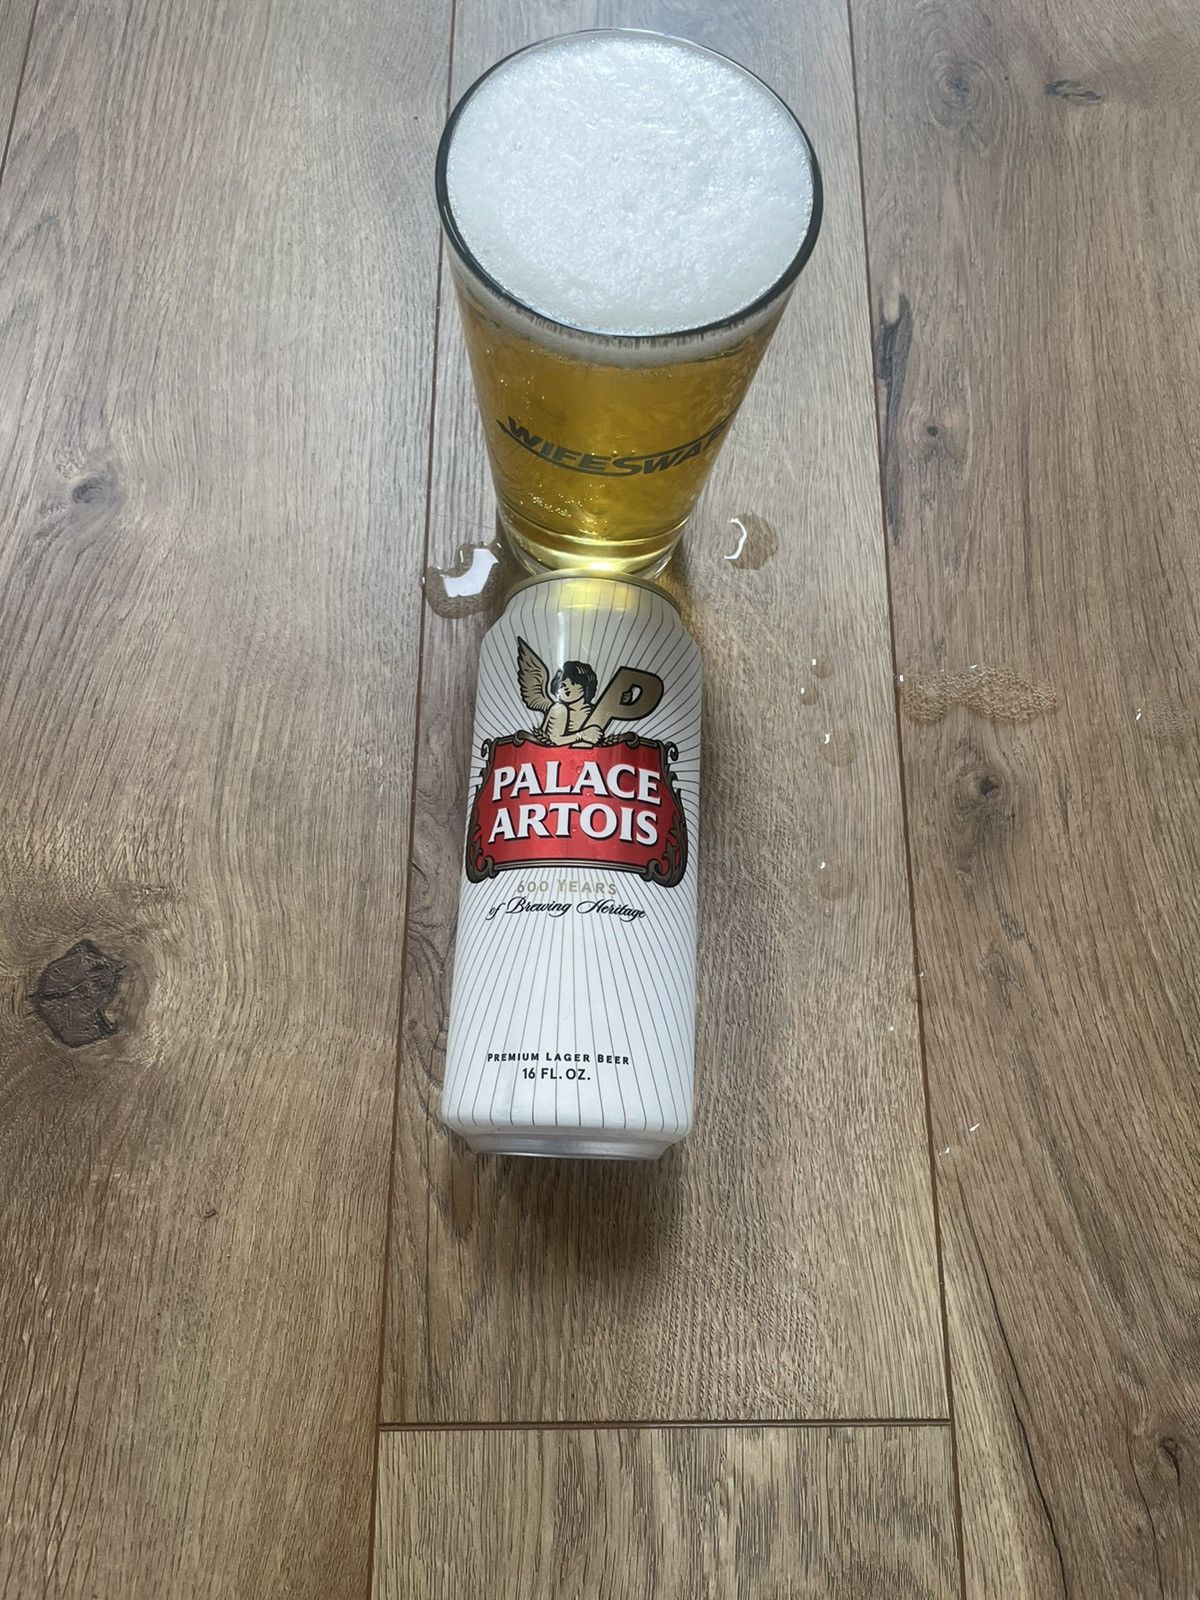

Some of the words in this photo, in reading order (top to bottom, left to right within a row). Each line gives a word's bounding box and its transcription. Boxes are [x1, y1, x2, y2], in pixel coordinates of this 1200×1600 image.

[492, 760, 661, 805] PALACE
[487, 802, 659, 846] ARTOIS
[517, 879, 549, 894] 600
[557, 878, 617, 895] YEARS
[485, 902, 506, 921] of
[505, 896, 572, 918] Brewing
[576, 899, 646, 923] Heritage
[487, 1052, 540, 1062] PREMIUM
[545, 1052, 591, 1062] LAGER
[597, 1054, 630, 1065] BEER
[522, 1067, 536, 1080] 16
